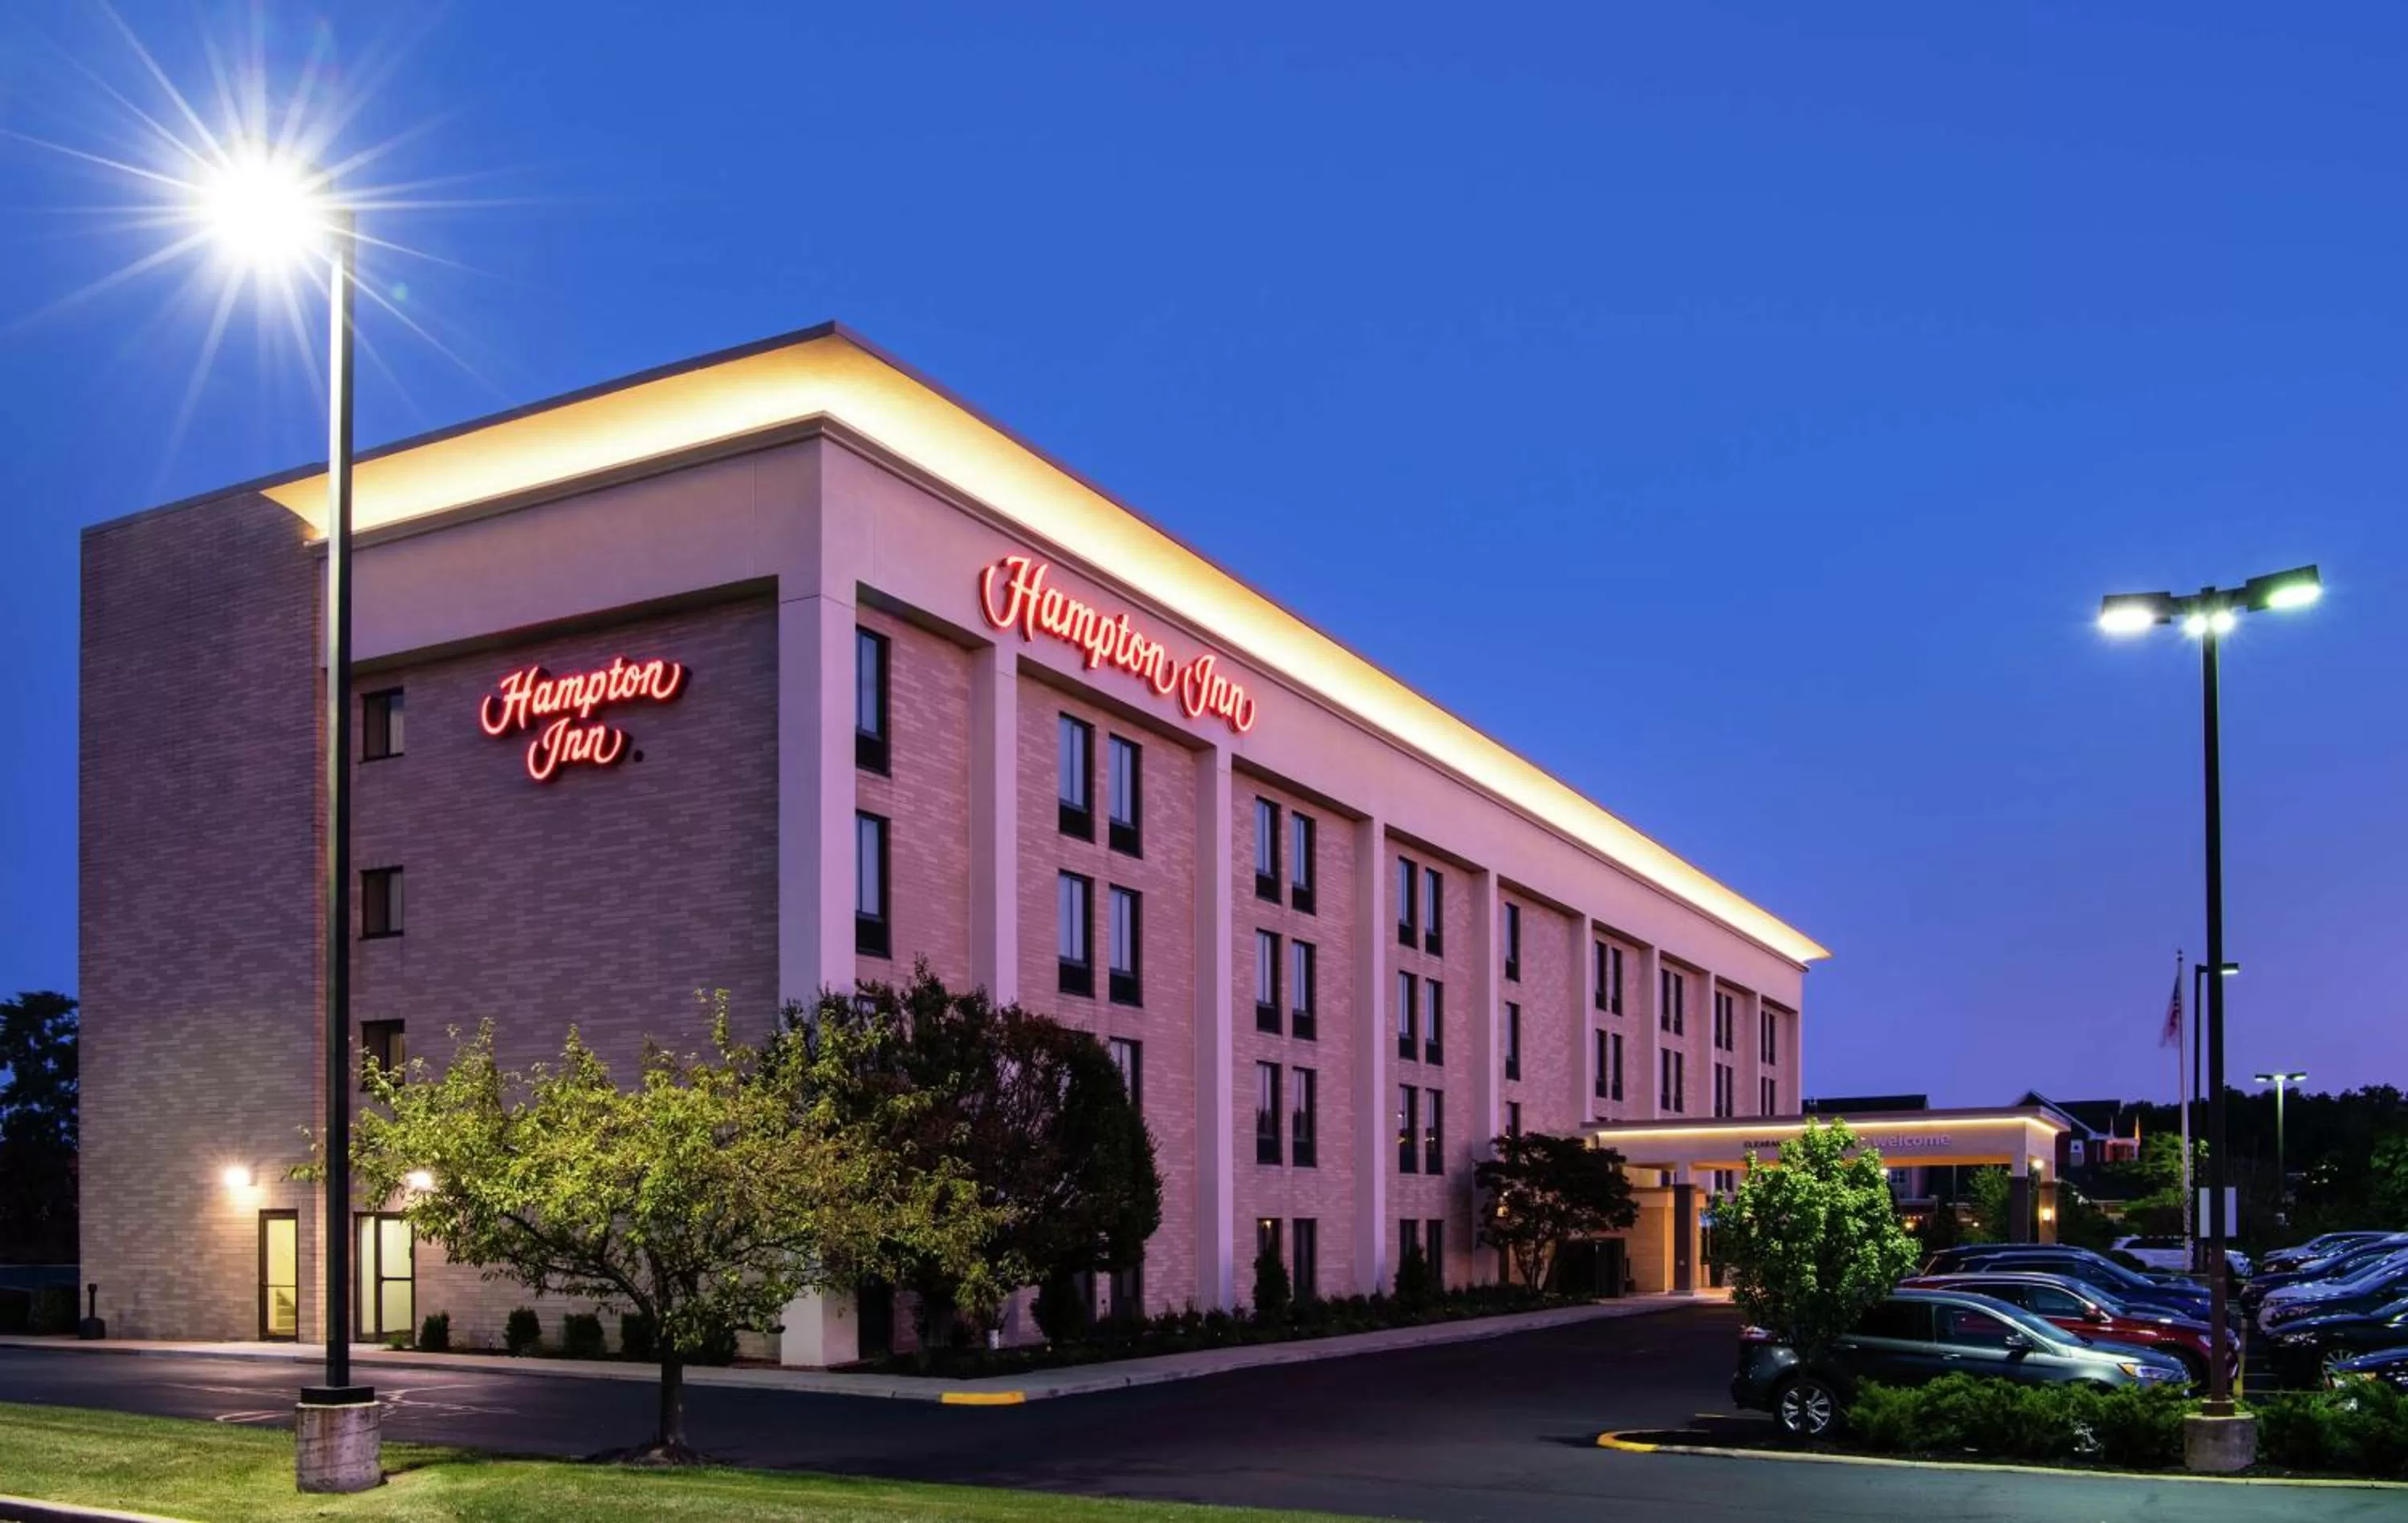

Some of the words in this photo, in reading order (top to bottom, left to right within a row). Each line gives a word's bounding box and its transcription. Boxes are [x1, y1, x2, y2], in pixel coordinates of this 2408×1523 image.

[980, 555, 1178, 694] Hampton
[1179, 654, 1255, 732] Inn
[481, 656, 682, 736] Hampton
[527, 717, 624, 781] Inn
[1743, 1139, 1781, 1148] CLEARAN
[1872, 1131, 1952, 1147] welcome
